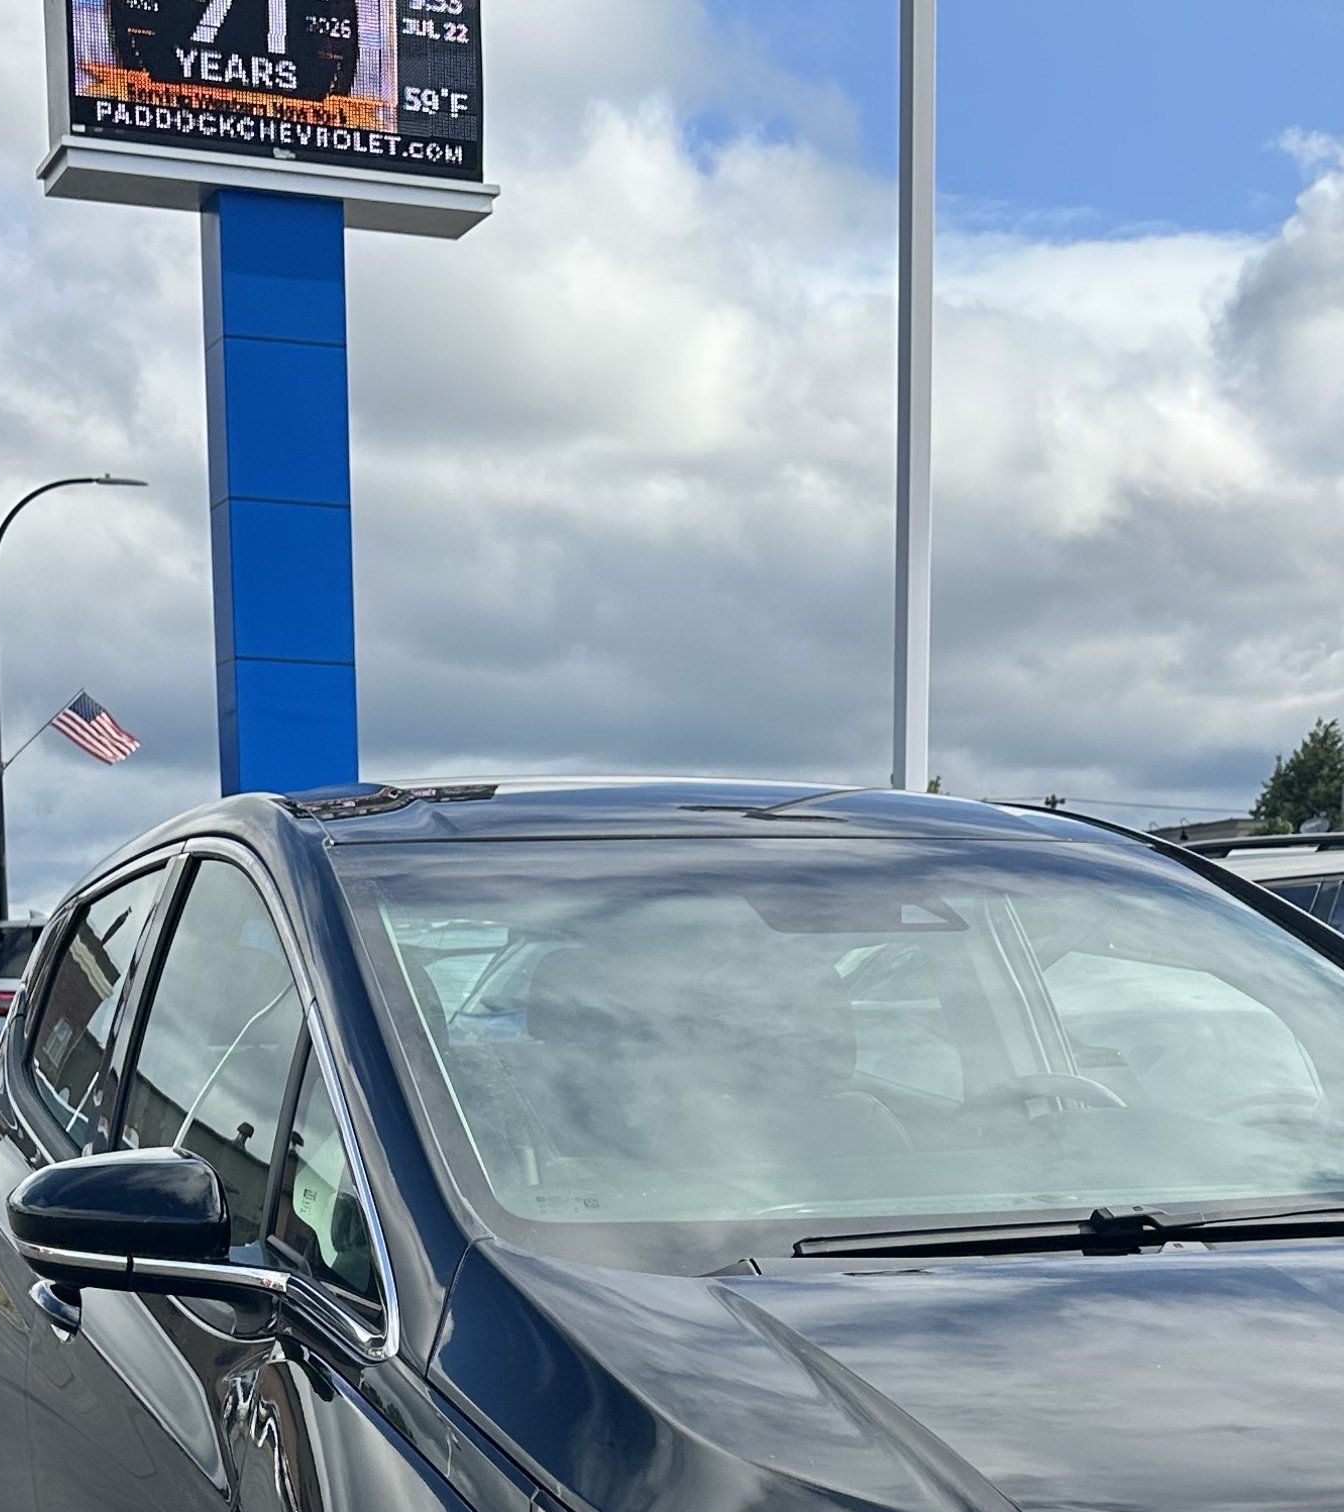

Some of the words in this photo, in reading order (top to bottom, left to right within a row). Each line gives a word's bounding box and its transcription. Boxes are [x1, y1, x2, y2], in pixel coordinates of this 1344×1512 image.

[402, 17, 441, 40] JUL
[443, 21, 470, 44] 22
[175, 47, 298, 90] YEARS
